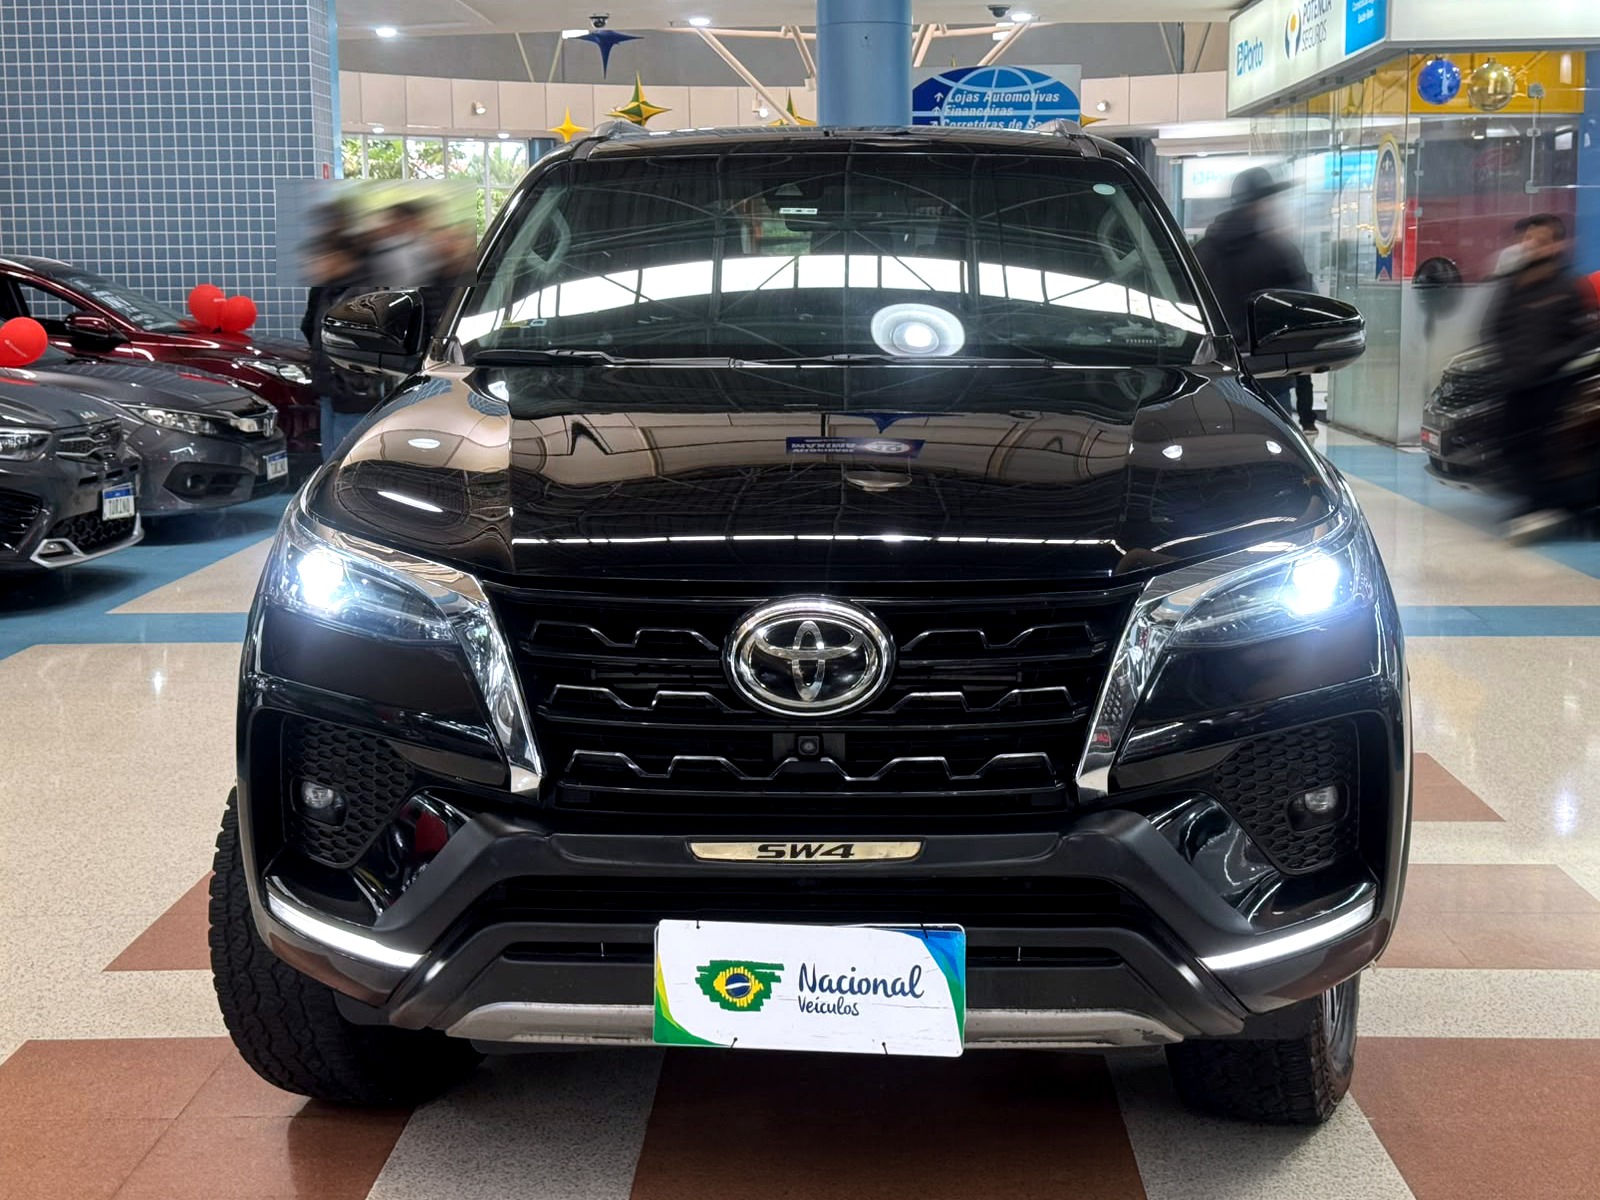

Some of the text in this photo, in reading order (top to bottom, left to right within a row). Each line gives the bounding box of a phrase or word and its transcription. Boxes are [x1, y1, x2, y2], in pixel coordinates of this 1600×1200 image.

[1302, 19, 1327, 51] SEGUROS
[1243, 36, 1264, 74] Porto
[949, 90, 1060, 105] Lojas Automotivas
[944, 105, 1014, 117] Financeiras
[1007, 118, 1023, 130] de
[756, 844, 855, 859] SW4
[798, 963, 926, 999] Nacional
[798, 996, 860, 1017] Veículos
